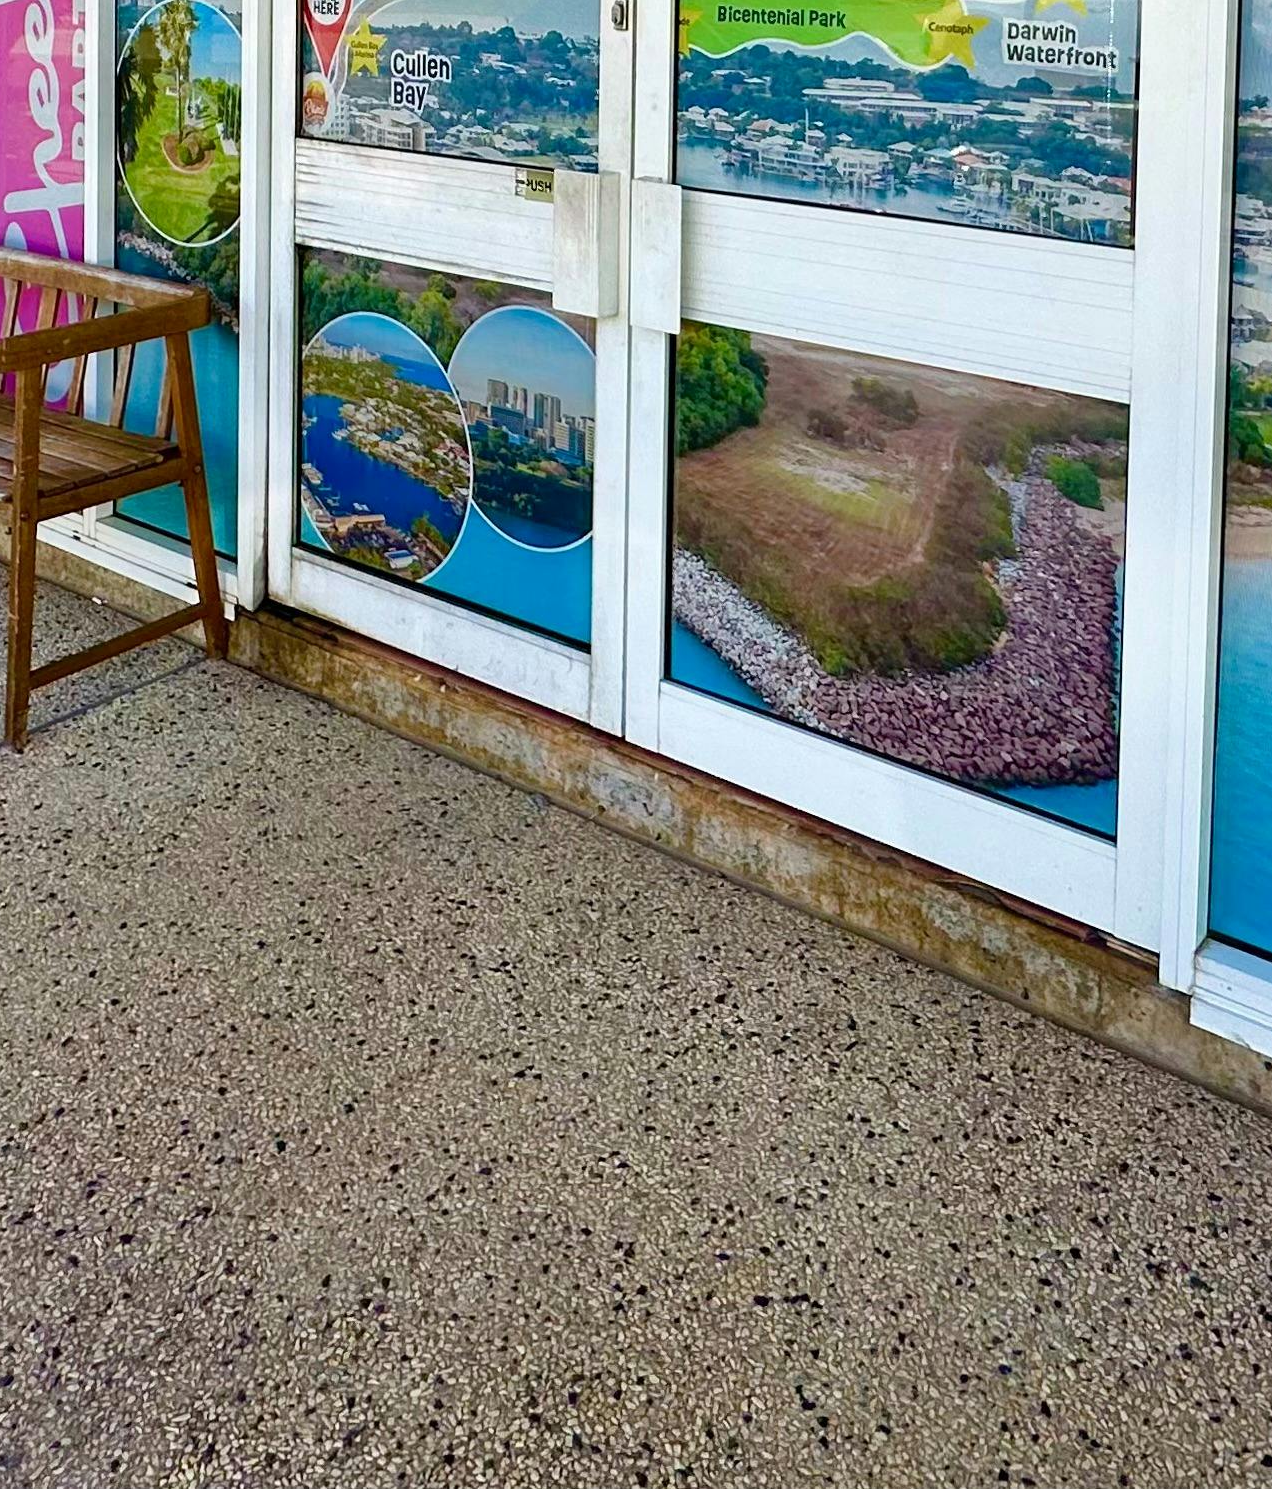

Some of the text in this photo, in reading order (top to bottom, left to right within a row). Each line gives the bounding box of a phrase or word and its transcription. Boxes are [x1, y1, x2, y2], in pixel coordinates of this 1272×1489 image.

[313, 1, 339, 16] HERE
[809, 9, 847, 29] Park
[928, 21, 974, 35] Cenotaph
[1007, 23, 1076, 43] Darwin
[393, 53, 450, 79] Cullen
[1006, 44, 1117, 69] Waterfront
[393, 83, 426, 109] Bay
